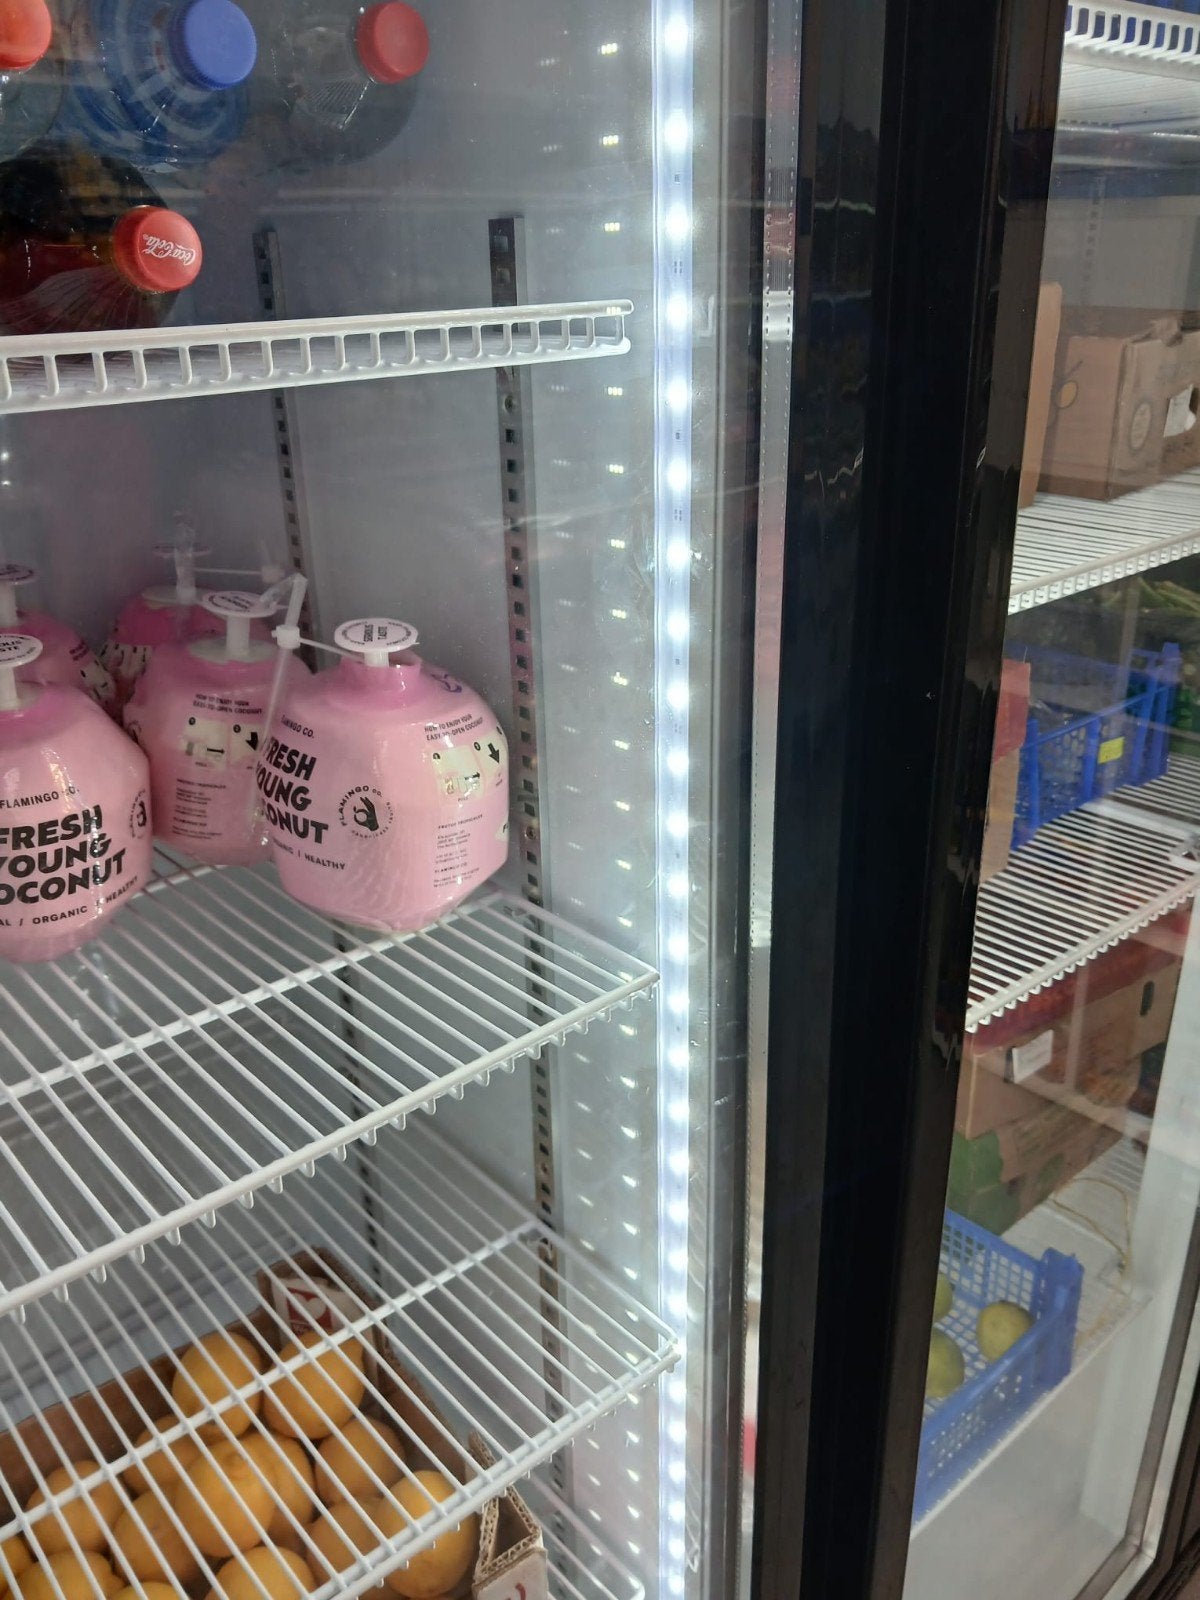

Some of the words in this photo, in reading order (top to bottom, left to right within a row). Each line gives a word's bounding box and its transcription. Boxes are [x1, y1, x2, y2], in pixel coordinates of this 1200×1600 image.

[0, 791, 59, 809] FLAMINGO
[338, 785, 369, 826] FLAMINGO
[304, 852, 346, 870] HEALTHY
[32, 906, 88, 925] ORGANIC
[106, 876, 138, 903] HEALTHY
